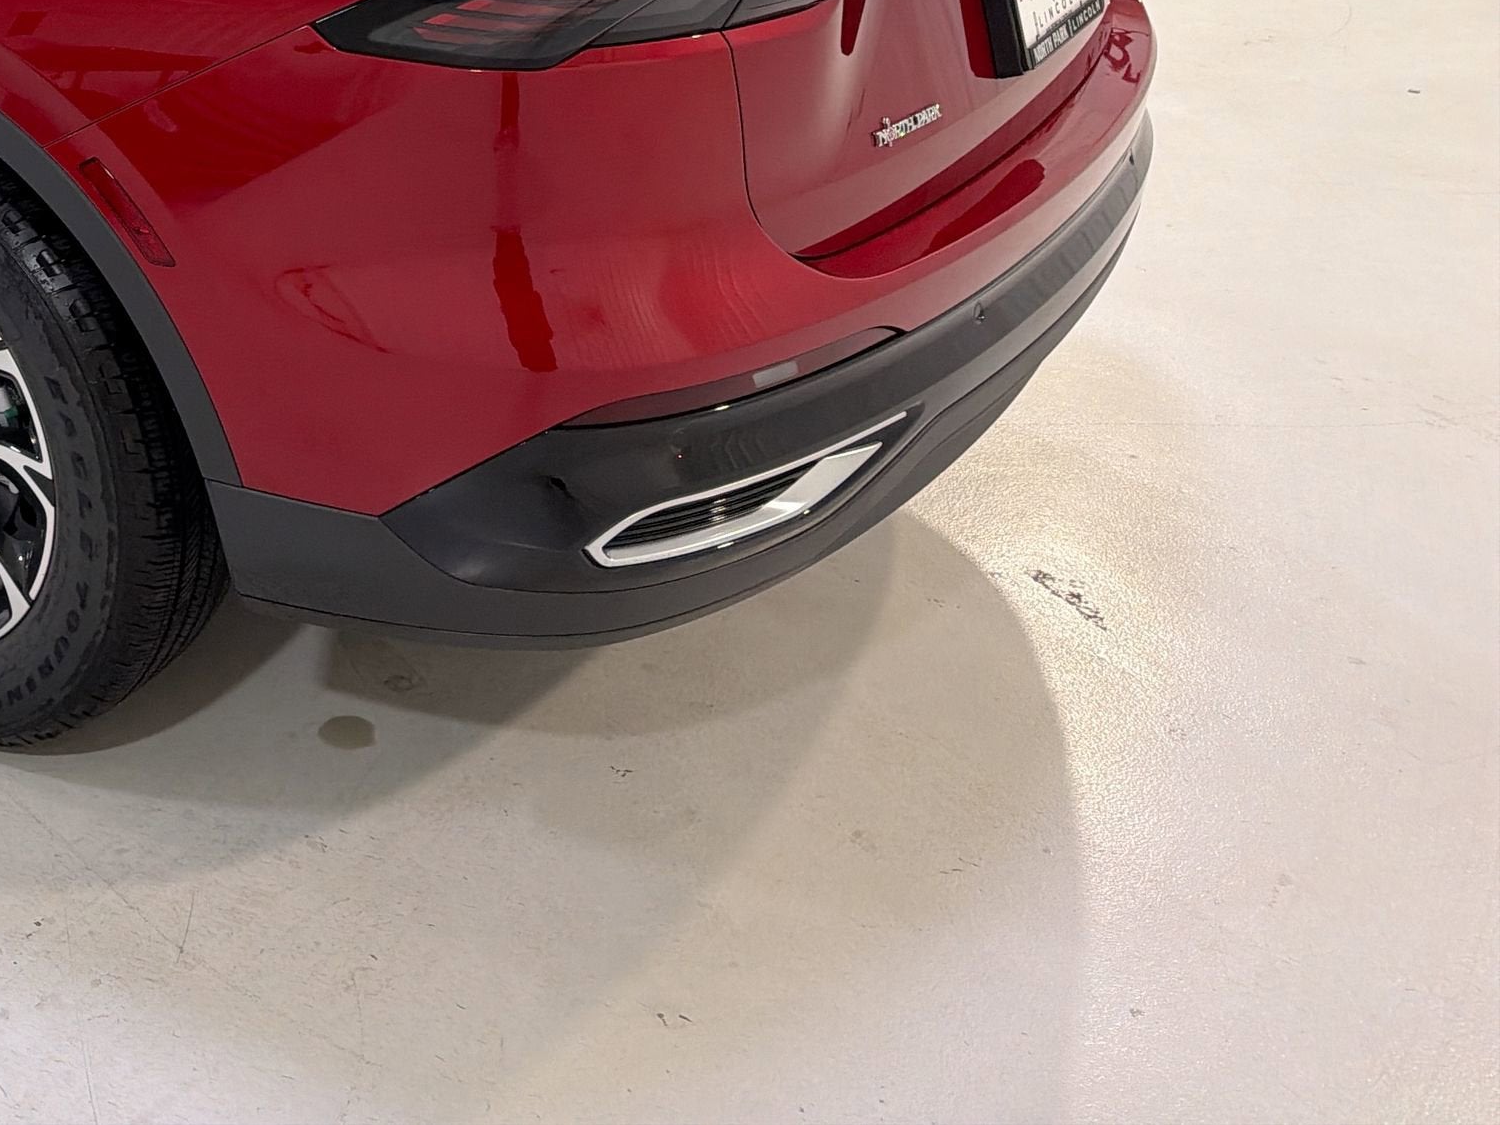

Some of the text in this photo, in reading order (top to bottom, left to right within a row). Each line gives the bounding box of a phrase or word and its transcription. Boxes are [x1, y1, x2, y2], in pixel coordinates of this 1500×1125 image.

[1033, 34, 1052, 64] NORTH
[1052, 23, 1070, 48] PARK
[876, 104, 942, 147] NORTH PARK
